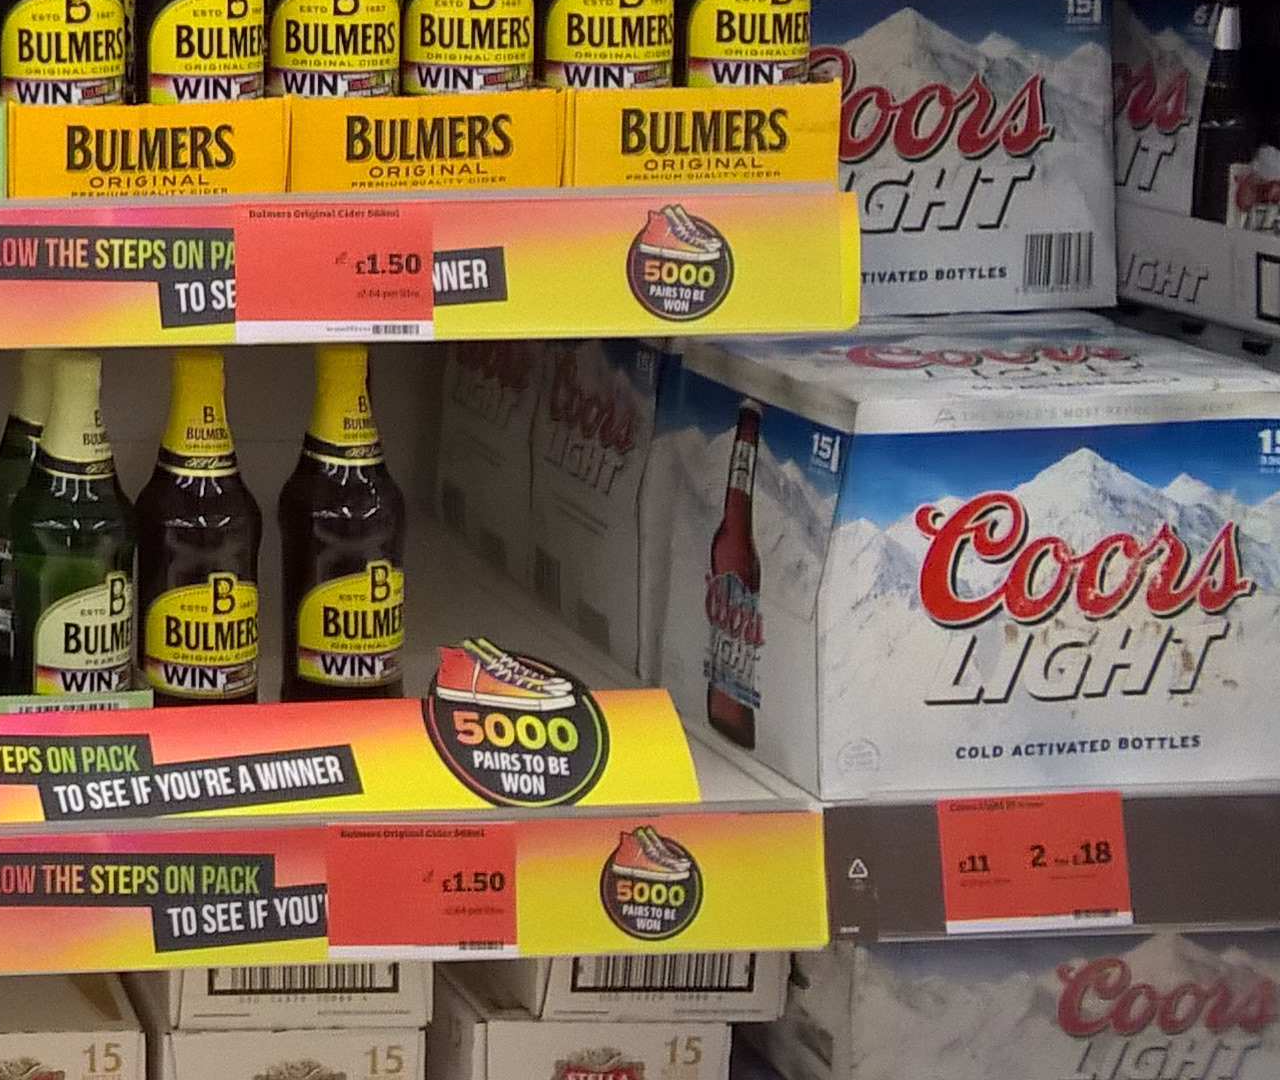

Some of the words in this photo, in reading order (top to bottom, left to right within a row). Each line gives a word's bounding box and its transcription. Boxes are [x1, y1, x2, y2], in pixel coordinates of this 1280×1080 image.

[285, 19, 395, 56] BULMERS
[567, 13, 674, 48] BULMERS
[291, 58, 355, 68] ORIGINAL
[359, 58, 391, 67] CIDER
[283, 72, 338, 96] WIN
[620, 107, 788, 156] BULMERS
[65, 124, 235, 173] BULMERS
[626, 173, 682, 181] PREMIUM
[743, 170, 781, 179] CIDER
[643, 158, 763, 170] ORIGINAL
[337, 210, 364, 218] Cider
[355, 253, 422, 275] £1.50
[915, 489, 1255, 628] Coors
[165, 615, 257, 652] BULMERS
[164, 664, 218, 689] WIN
[924, 621, 1231, 707] LIGHT
[48, 746, 78, 774] ON
[82, 744, 139, 773] PACK
[955, 743, 1007, 761] COLD
[1011, 739, 1113, 759] ACTIVATED
[1118, 735, 1202, 754] BOTTLES
[54, 784, 82, 813] TO
[88, 780, 129, 810] SEE
[134, 776, 150, 806] IF
[154, 766, 234, 802] YOU'RE
[240, 766, 254, 794] A
[257, 756, 344, 790] WINNER
[959, 854, 990, 874] £11
[1030, 845, 1047, 868] 2
[1073, 840, 1112, 867] £18
[615, 880, 686, 904] 5000
[622, 904, 649, 918] PAIRS
[650, 905, 661, 919] TO
[663, 907, 677, 921] BE
[636, 917, 661, 931] WON
[82, 1043, 123, 1073] 15
